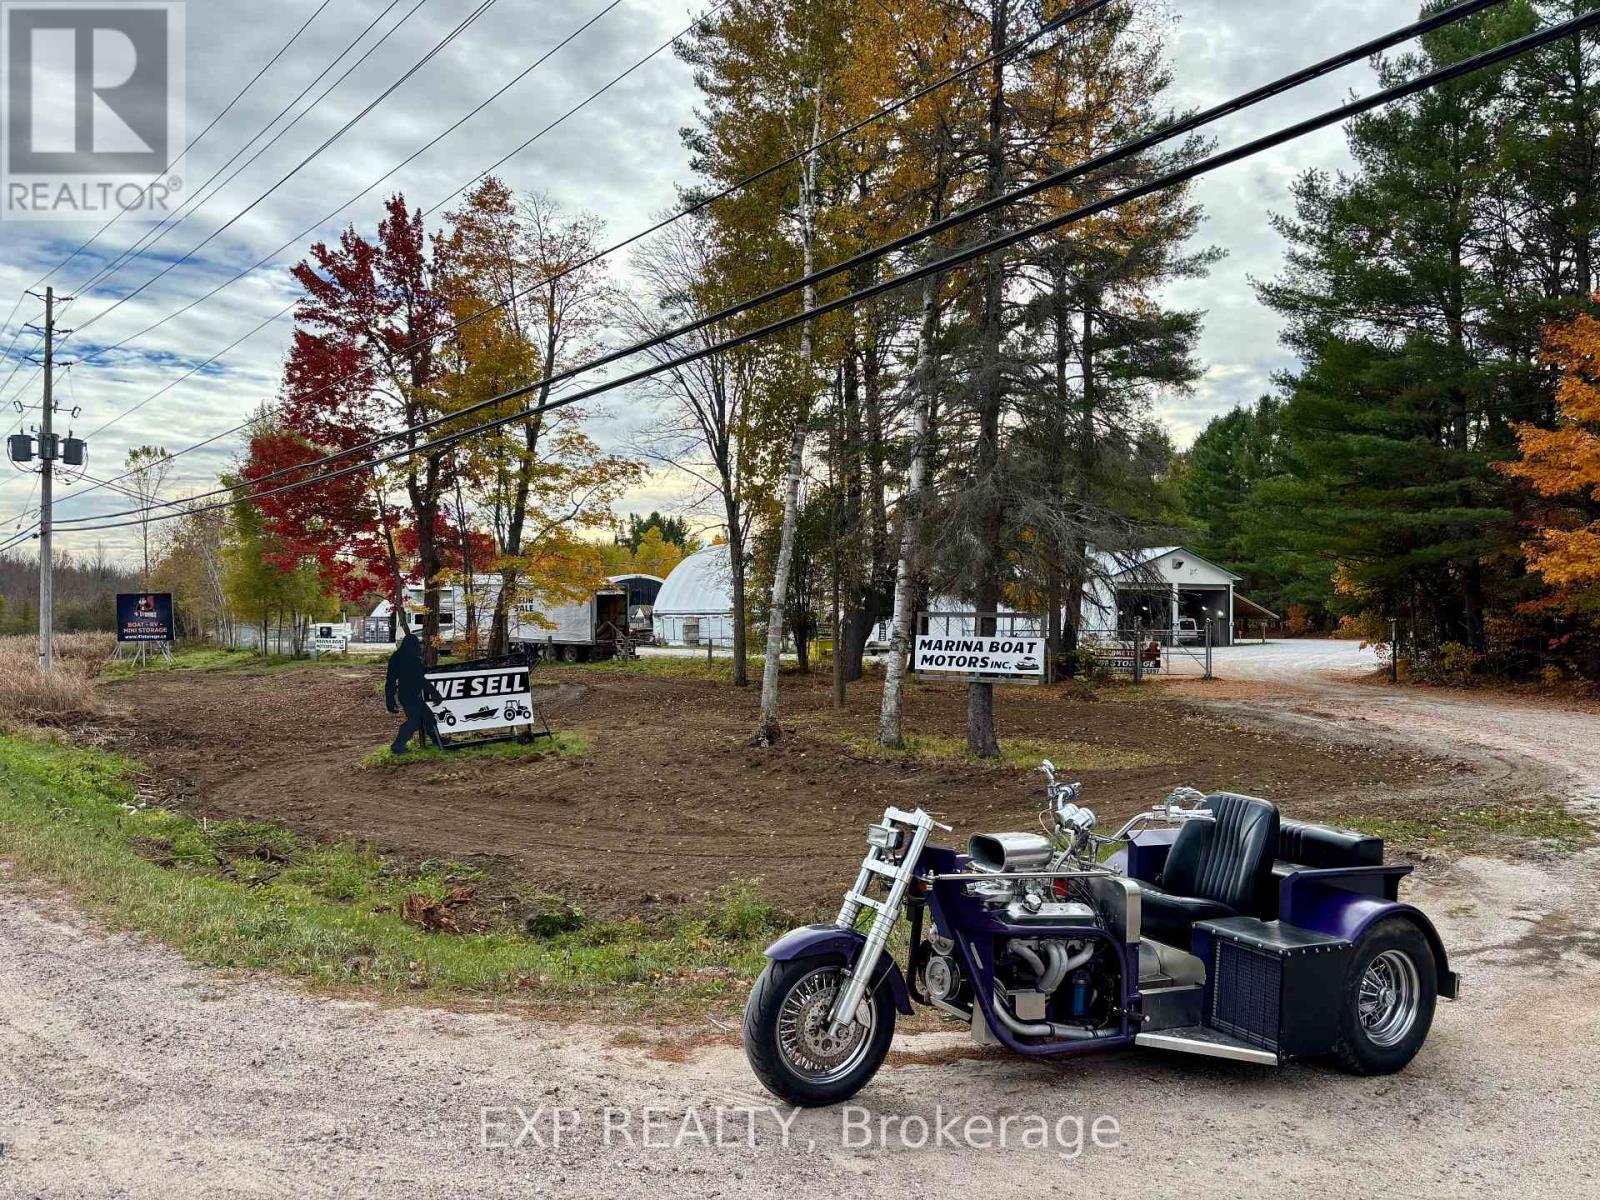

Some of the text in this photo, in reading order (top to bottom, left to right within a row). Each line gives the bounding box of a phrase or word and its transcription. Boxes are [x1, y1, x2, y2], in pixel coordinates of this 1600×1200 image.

[514, 604, 534, 612] SALE
[919, 639, 1037, 654] MARINA BOAT
[920, 654, 1012, 670] MOTORS INC.
[1109, 660, 1156, 668] STOGE
[430, 674, 525, 698] WE SELL
